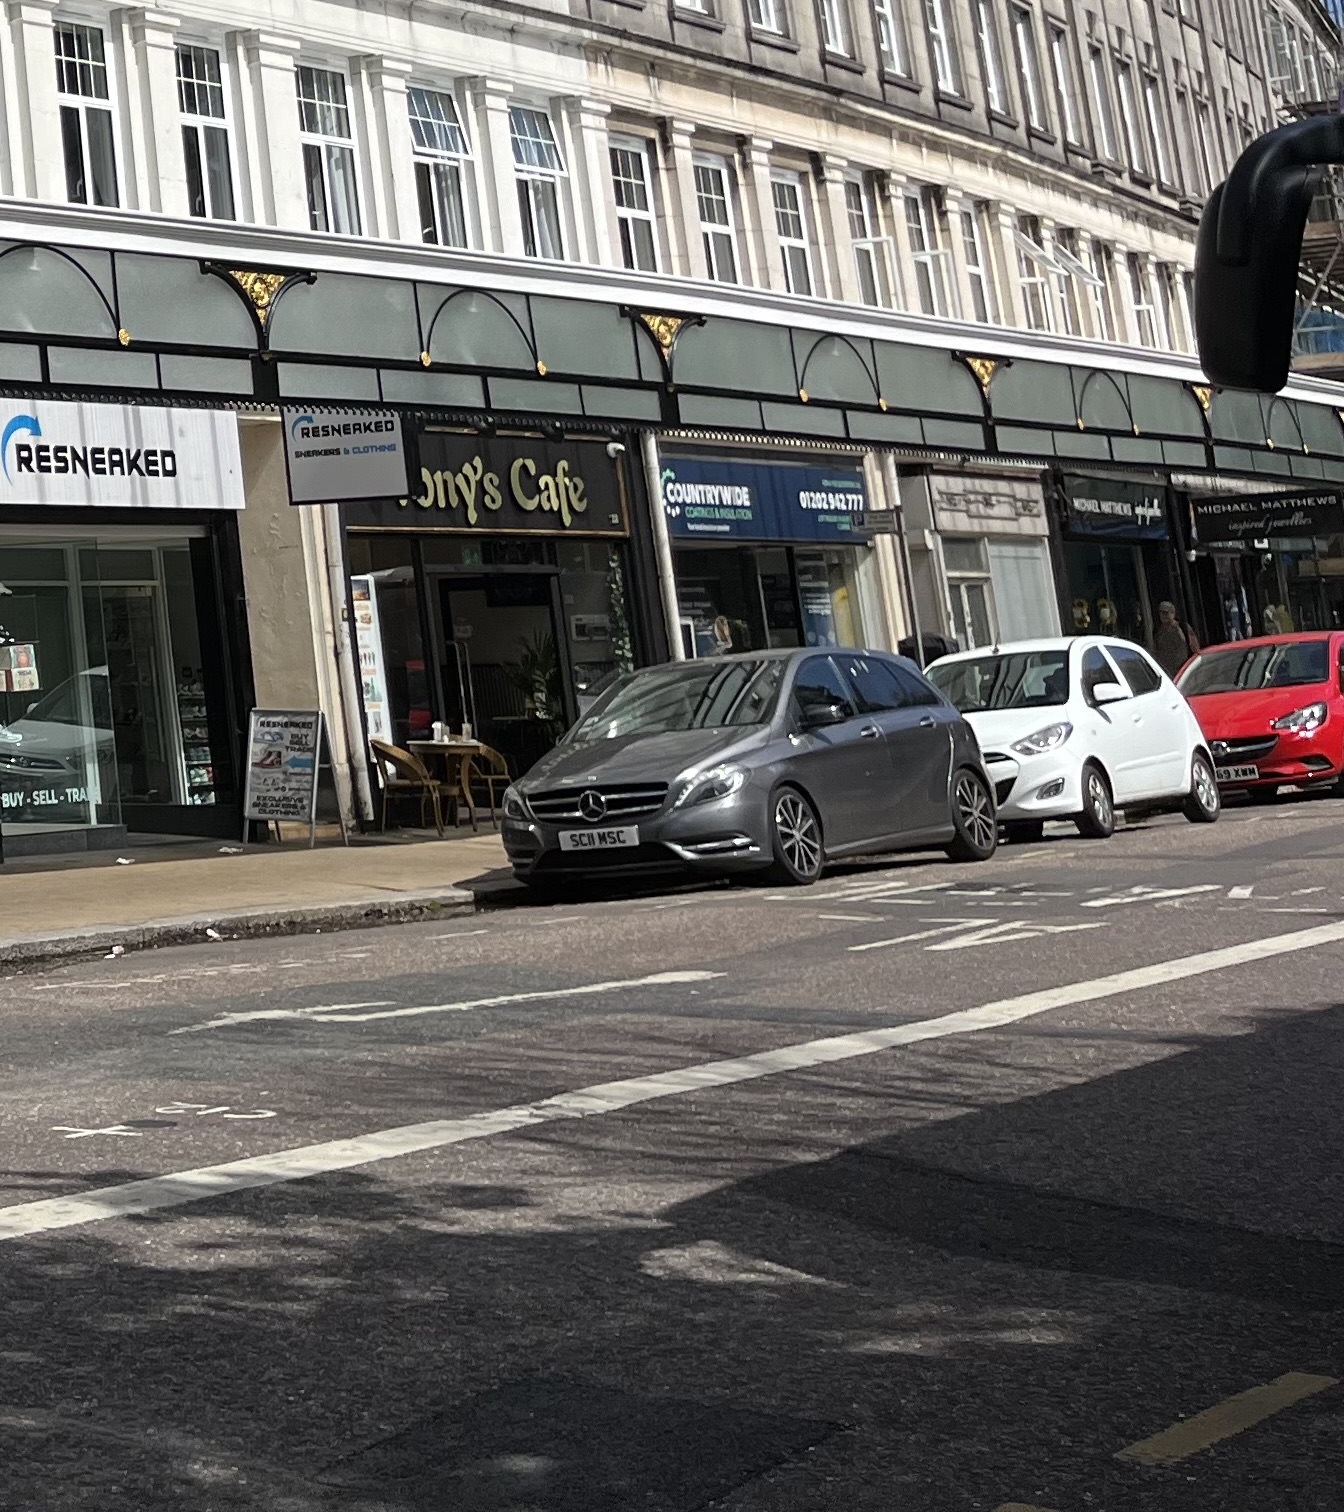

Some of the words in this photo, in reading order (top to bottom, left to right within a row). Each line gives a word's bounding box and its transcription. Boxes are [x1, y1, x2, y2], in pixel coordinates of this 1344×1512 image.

[300, 420, 395, 439] RESNEAKED
[16, 442, 177, 479] RESNEAKED
[294, 447, 341, 458] SNEAKERS
[352, 443, 396, 455] CLOTHING
[399, 455, 502, 525] ony's
[510, 457, 588, 527] Cafe
[666, 482, 751, 506] COUNTRYWIDE
[1197, 502, 1257, 516] MICHAEL
[1262, 495, 1337, 511] MATTHEWS
[1, 791, 24, 808] BUY
[32, 789, 58, 806] SELL
